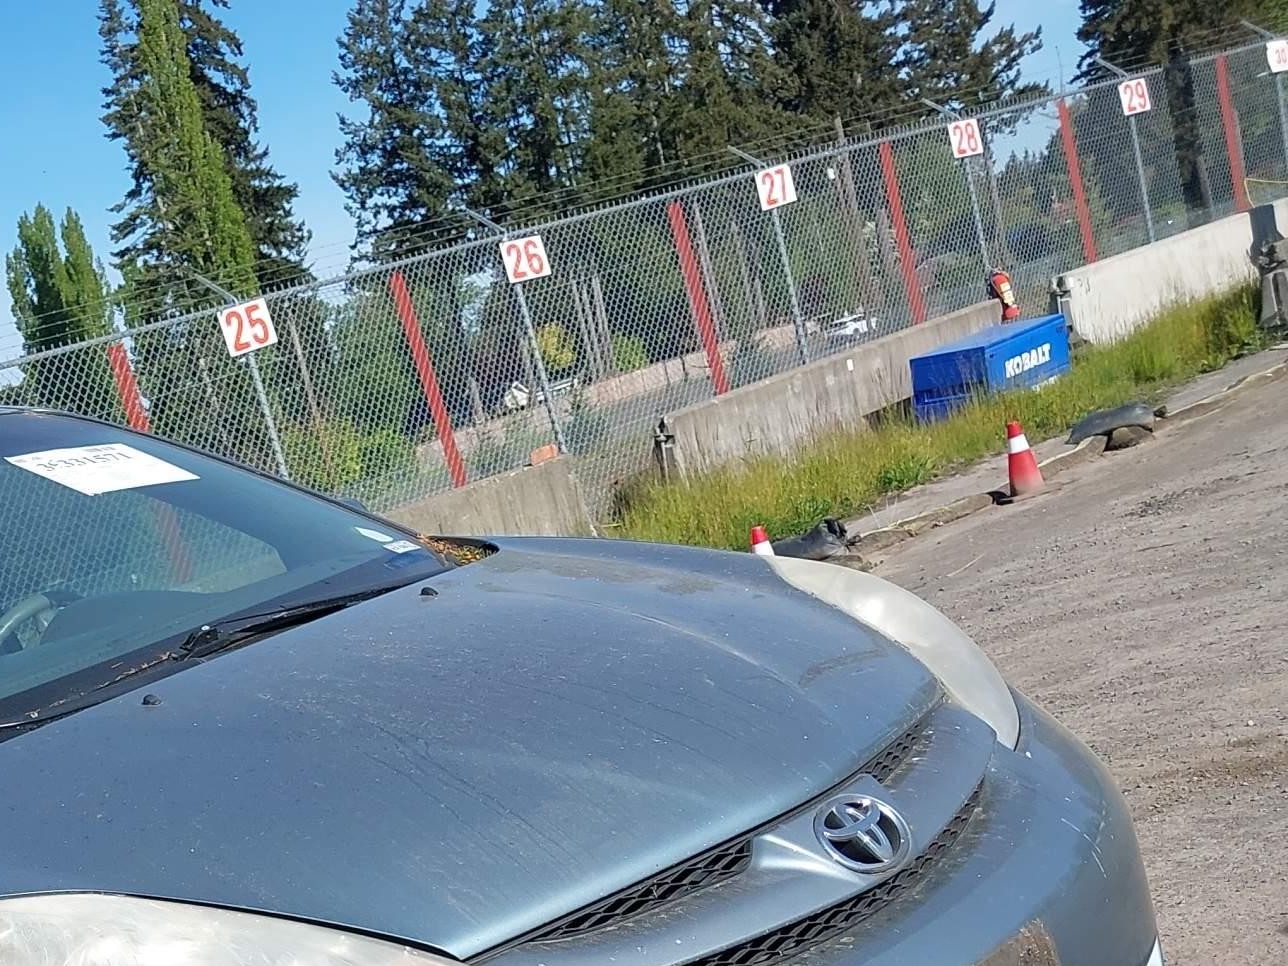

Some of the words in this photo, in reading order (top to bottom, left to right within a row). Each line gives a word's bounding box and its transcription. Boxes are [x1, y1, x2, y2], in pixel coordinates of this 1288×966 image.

[1123, 81, 1147, 112] 29
[952, 122, 978, 155] 28
[761, 168, 787, 206] 27
[506, 239, 544, 279] 26
[225, 304, 269, 352] 25
[1004, 342, 1051, 379] KOBALT
